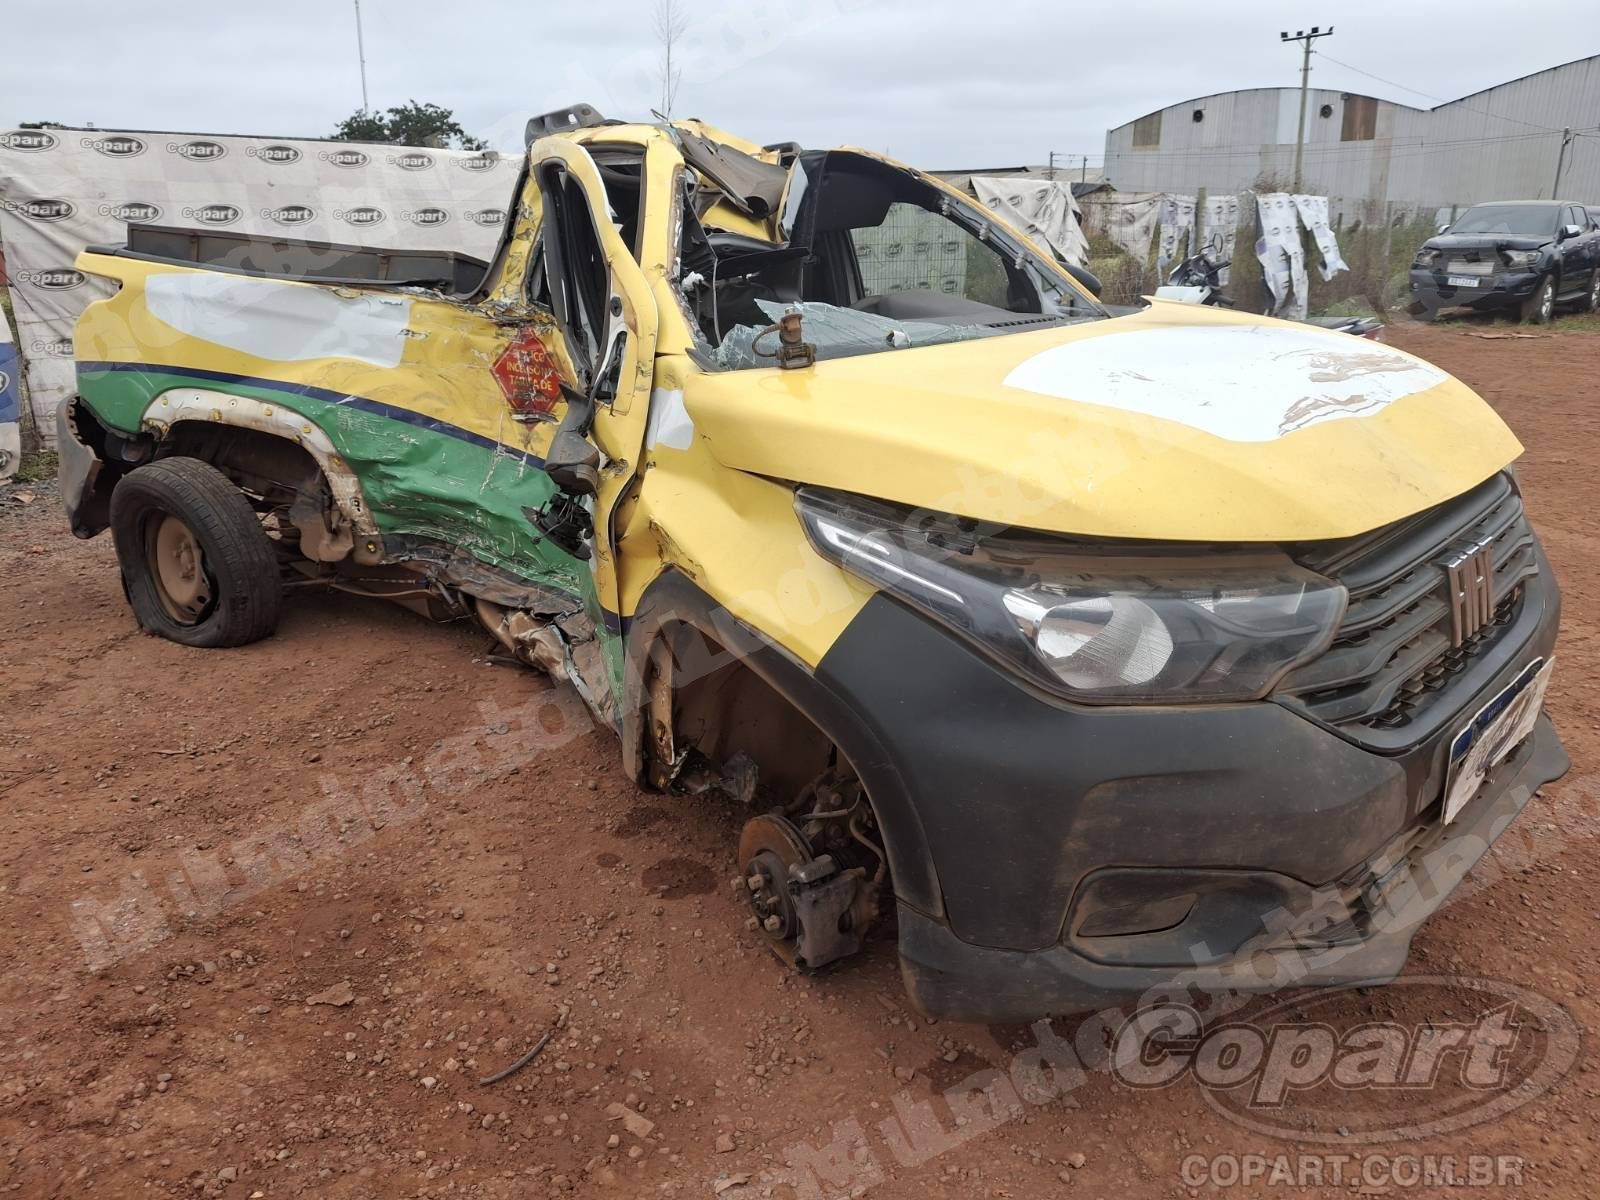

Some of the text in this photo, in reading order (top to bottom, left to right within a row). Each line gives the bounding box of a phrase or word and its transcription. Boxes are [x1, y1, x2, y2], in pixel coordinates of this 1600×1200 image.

[0, 133, 52, 148] opart
[80, 138, 140, 153] Copart
[166, 142, 221, 156] Copart
[246, 146, 296, 159] Copart
[319, 151, 365, 164] Copart
[386, 155, 430, 167] Copart
[4, 200, 71, 216] Copart
[98, 204, 155, 219] Copart
[182, 206, 235, 220] Copart
[260, 207, 312, 221] Copart
[333, 209, 379, 223] Copart
[401, 210, 445, 222] Copart
[464, 210, 504, 222] Copart
[16, 269, 80, 285] Copart
[31, 340, 73, 353] Copa
